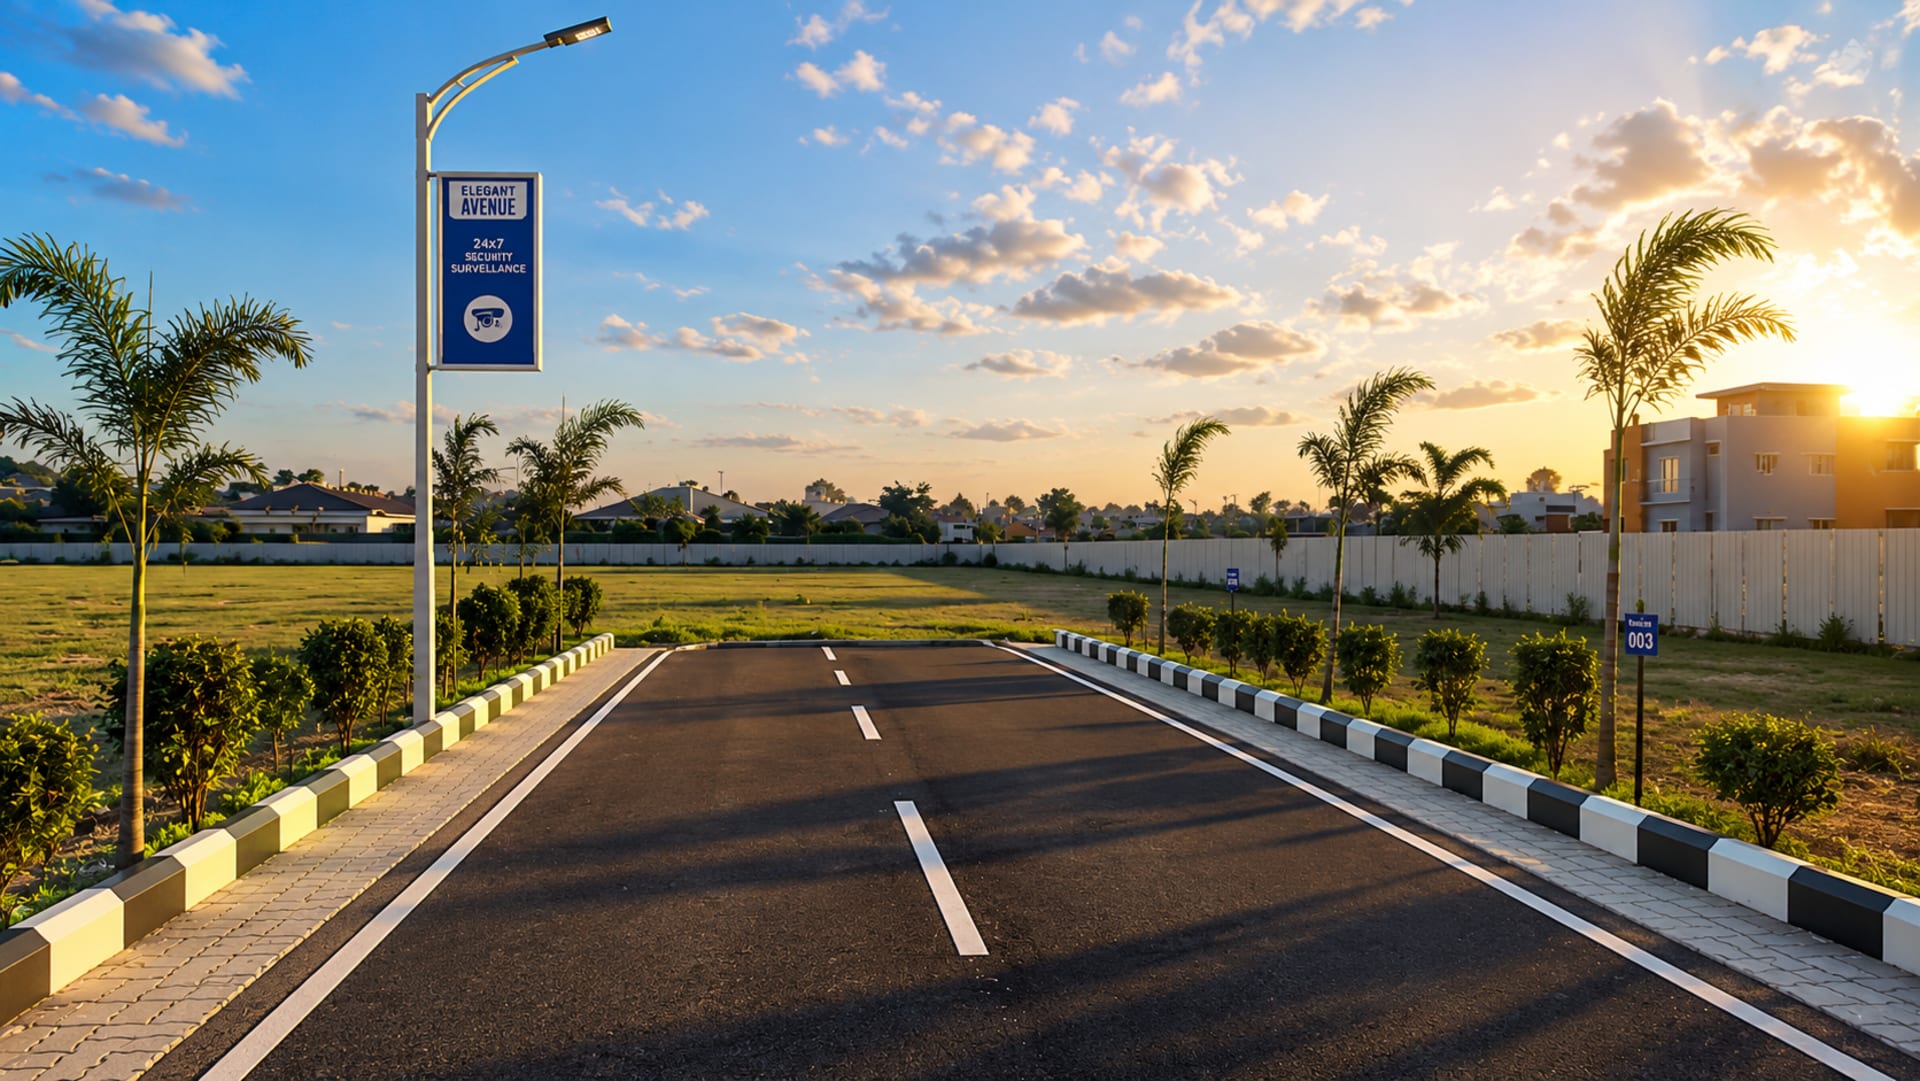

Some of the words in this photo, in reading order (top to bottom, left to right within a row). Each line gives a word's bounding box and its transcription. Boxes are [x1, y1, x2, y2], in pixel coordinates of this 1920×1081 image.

[461, 185, 516, 196] ELEGANT
[461, 197, 516, 216] AVENUE
[473, 238, 504, 249] 24x7
[1628, 631, 1653, 650] 003
